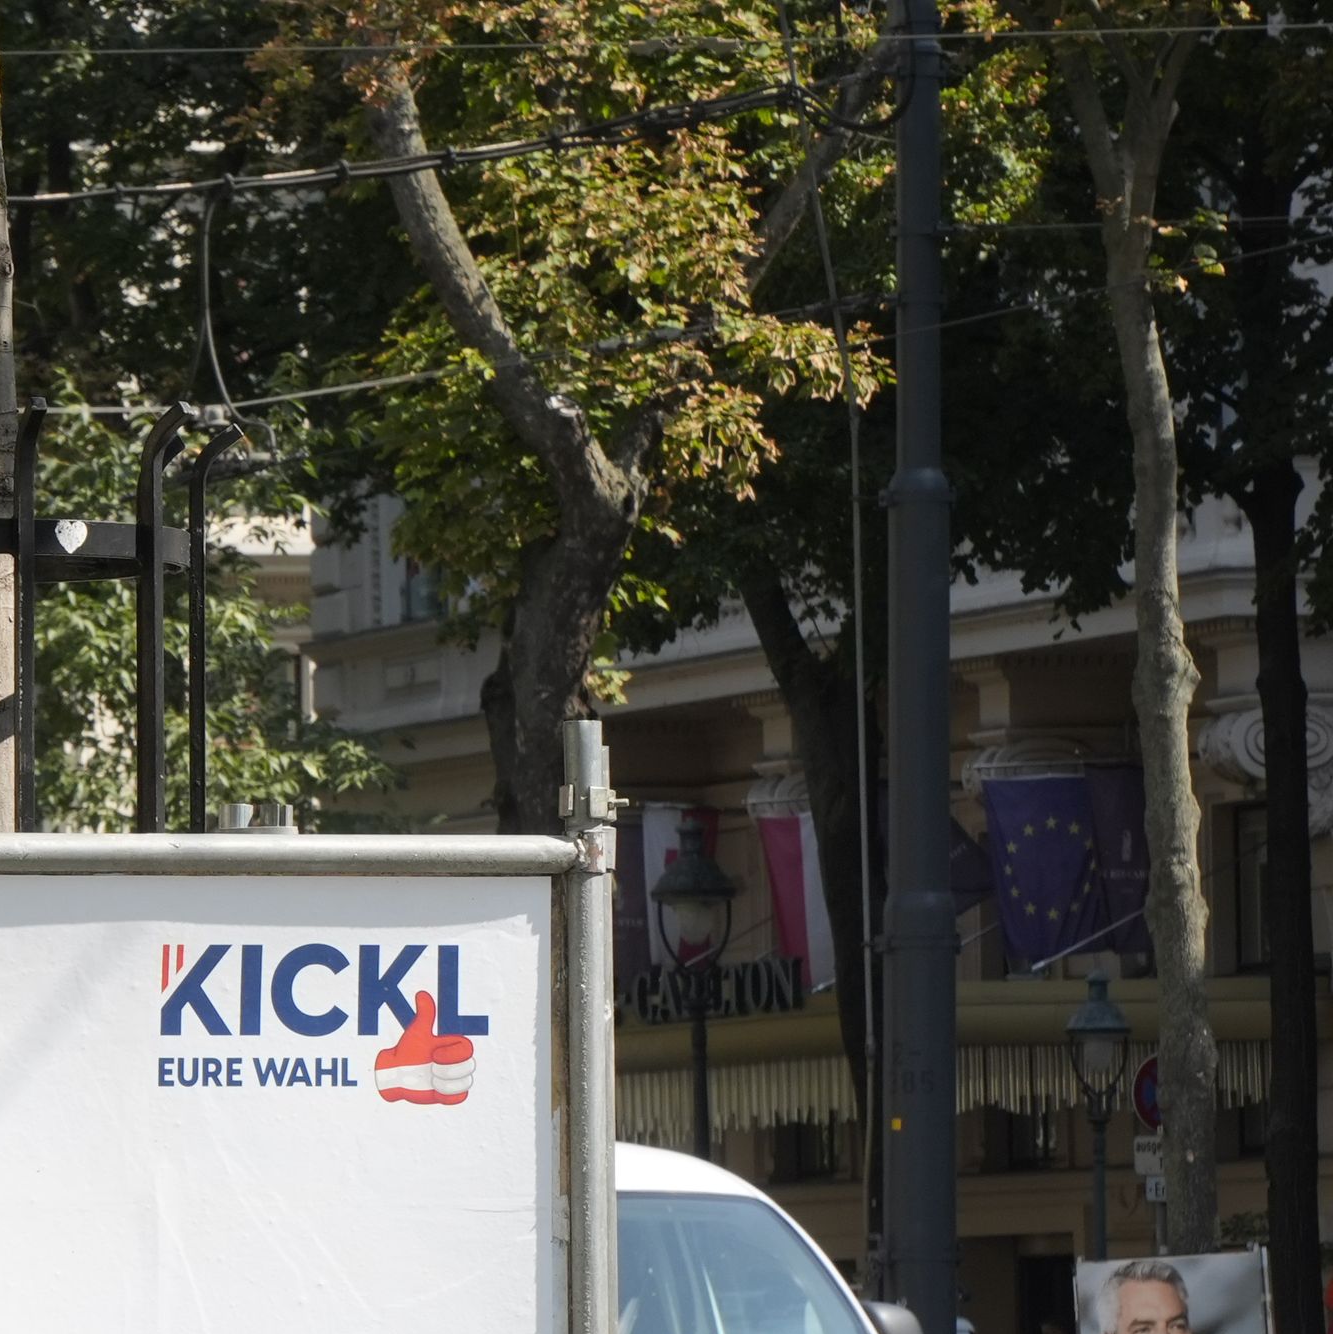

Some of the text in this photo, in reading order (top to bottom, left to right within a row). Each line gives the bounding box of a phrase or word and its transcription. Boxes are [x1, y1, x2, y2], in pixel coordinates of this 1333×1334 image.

[160, 943, 489, 1036] KICKL
[158, 1057, 358, 1087] EURE WAHL
